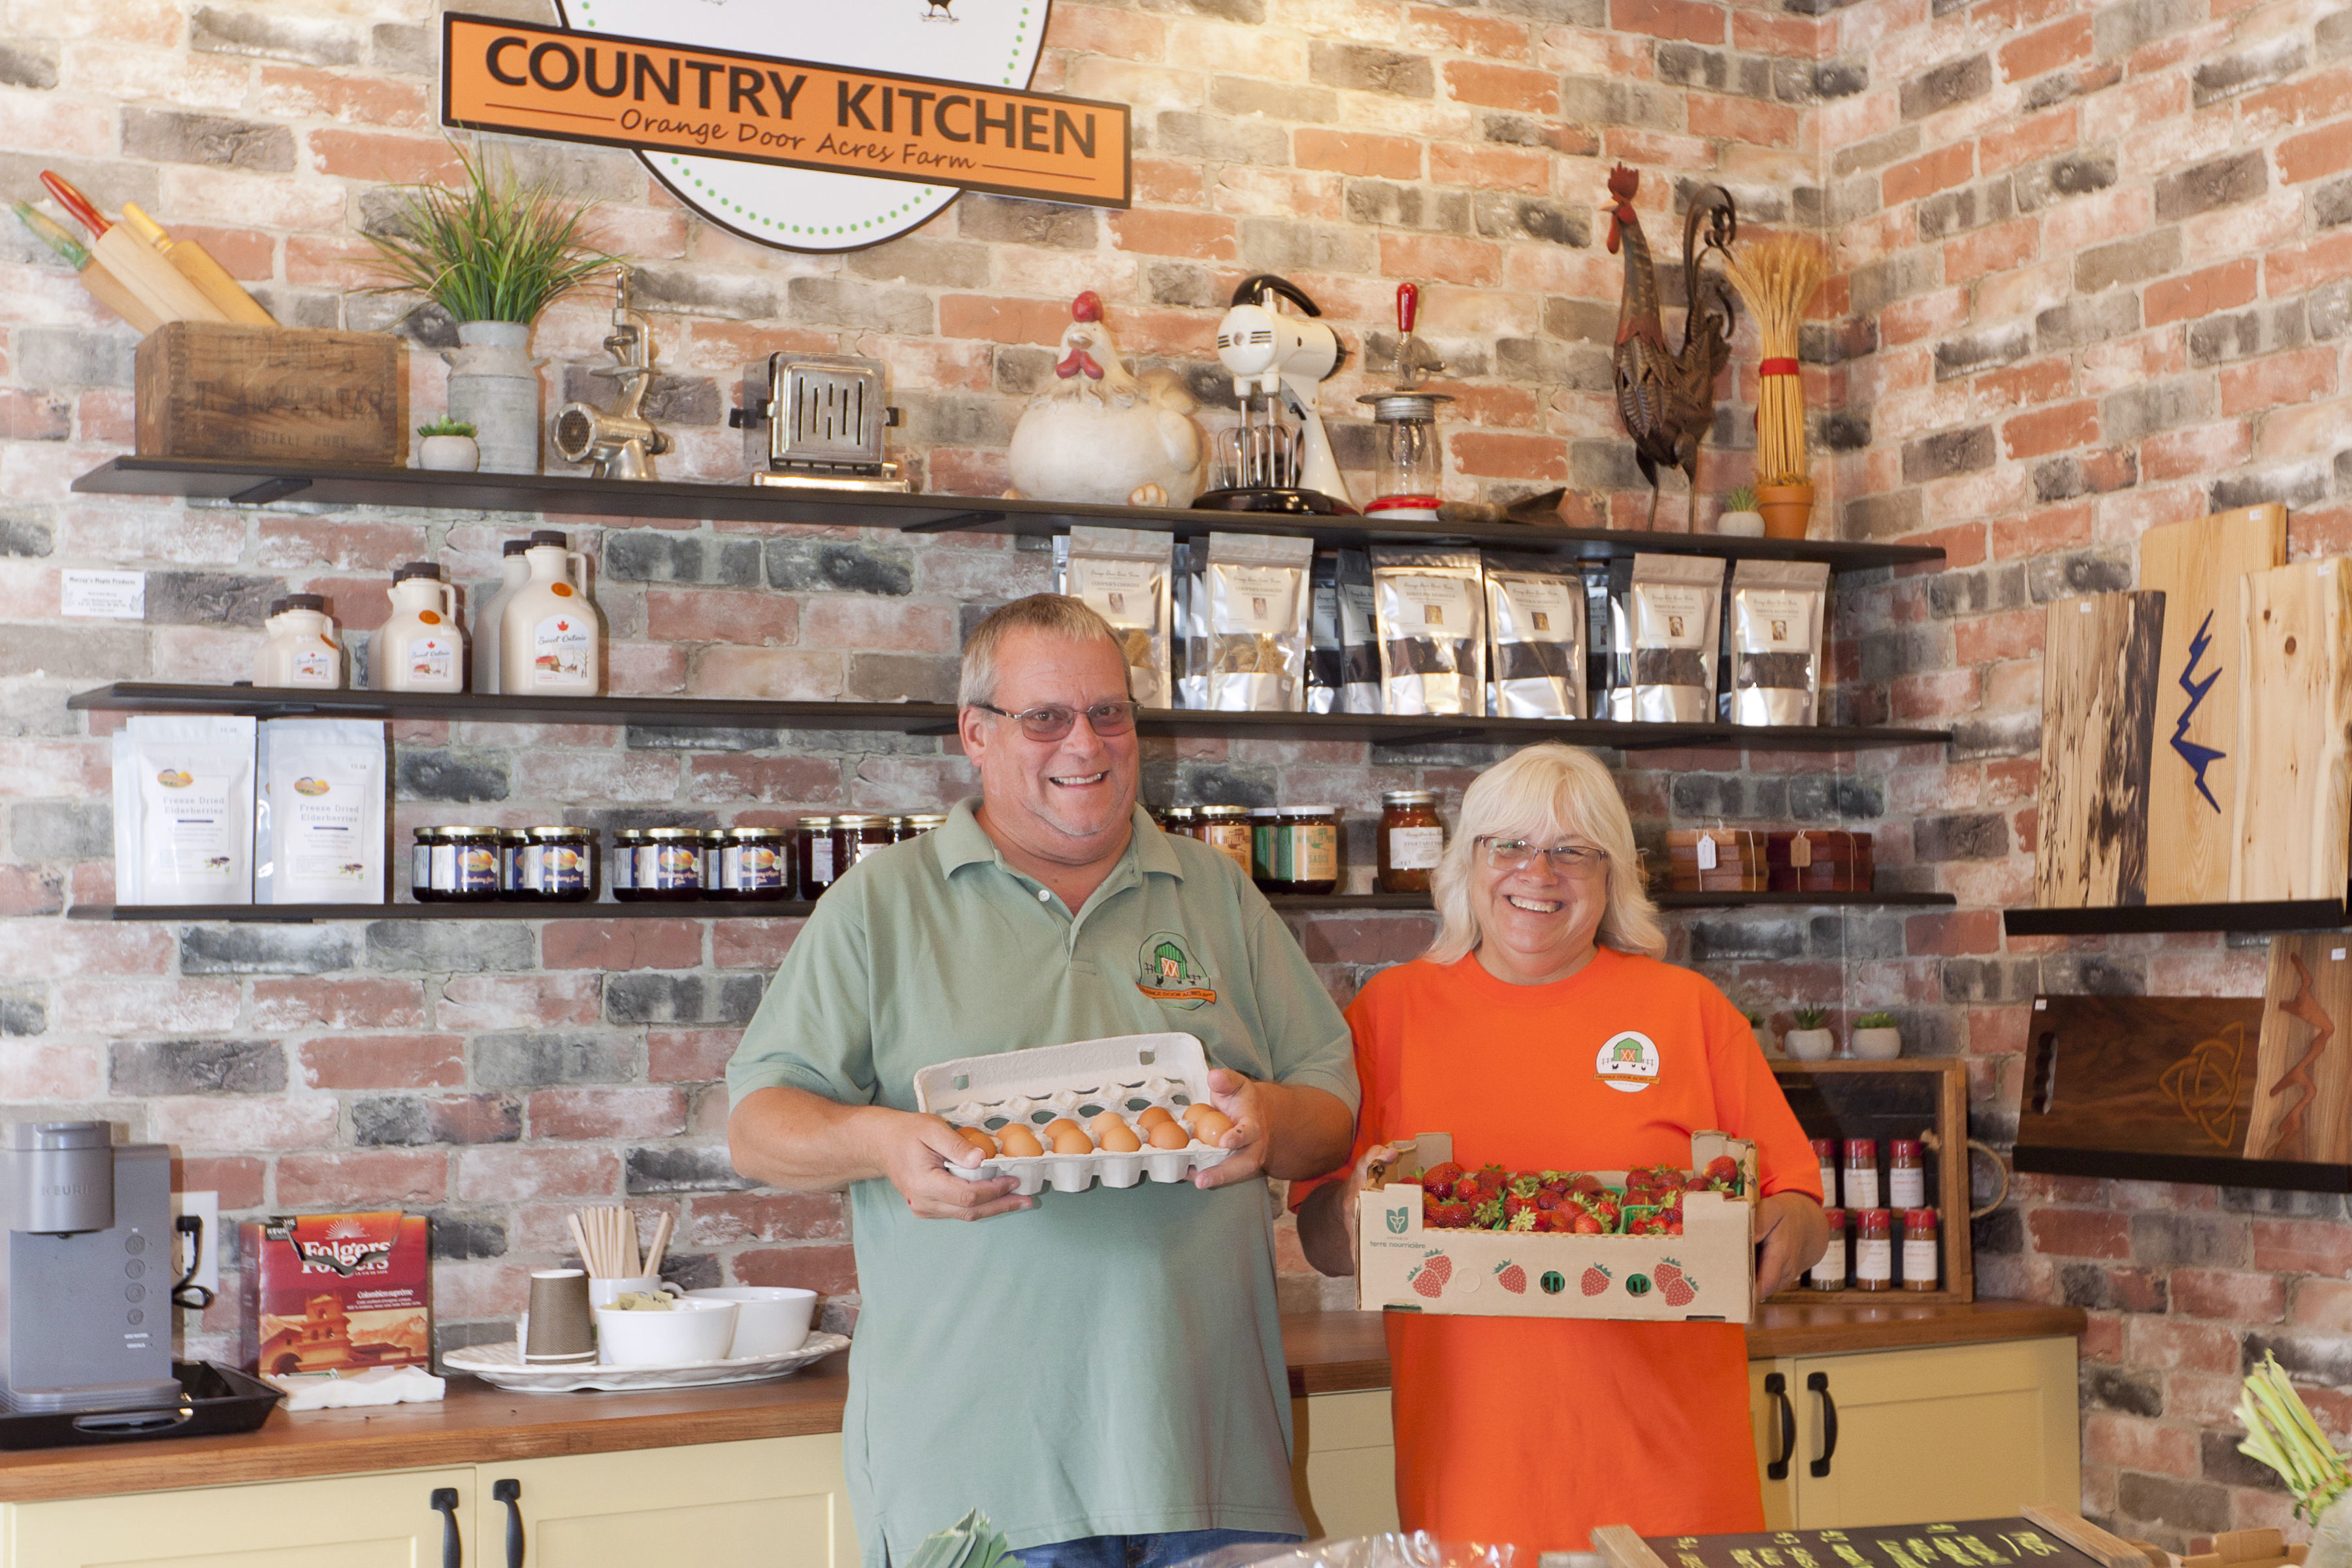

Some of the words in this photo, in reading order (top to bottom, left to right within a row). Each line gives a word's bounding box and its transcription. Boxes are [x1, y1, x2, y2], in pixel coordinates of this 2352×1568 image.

[486, 35, 808, 120] COUNTRY
[838, 80, 1096, 159] KITCHEN
[620, 108, 728, 145] Orange
[738, 123, 806, 153] Door
[815, 133, 895, 164] Acres
[902, 145, 978, 171] Farm
[163, 796, 195, 804] Freeze
[199, 796, 225, 804] Dried
[165, 806, 223, 815] Elderberries
[300, 804, 331, 812] Freeze
[335, 804, 359, 813] Dried
[301, 813, 358, 823] Elderberries
[302, 1241, 391, 1267] Folgers
